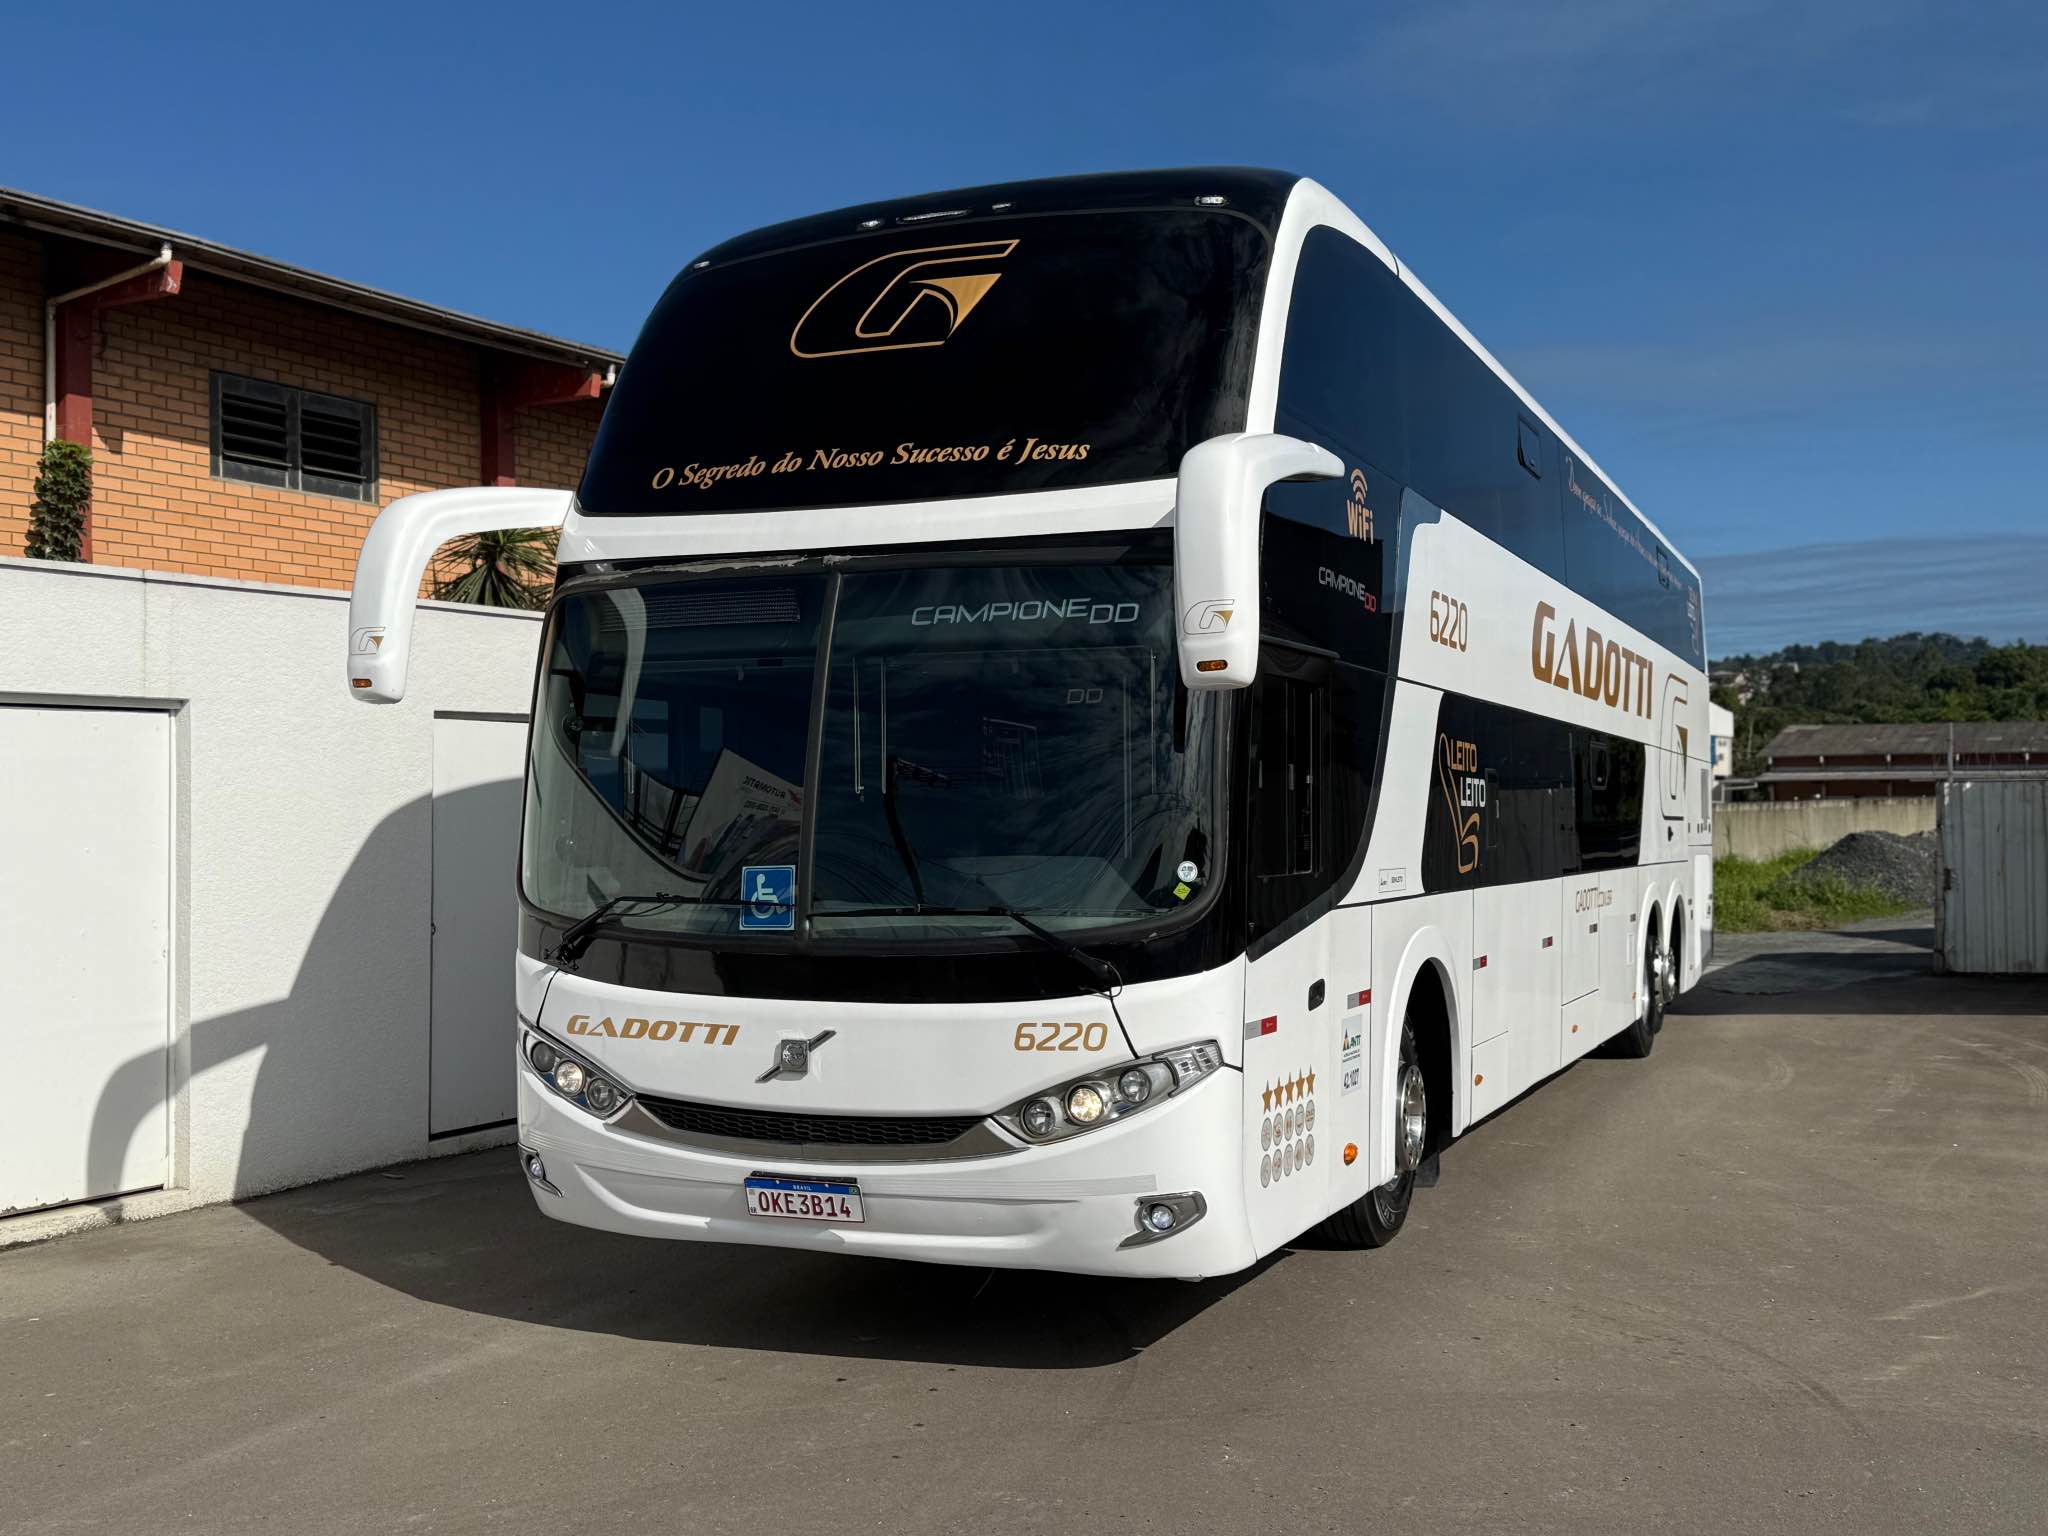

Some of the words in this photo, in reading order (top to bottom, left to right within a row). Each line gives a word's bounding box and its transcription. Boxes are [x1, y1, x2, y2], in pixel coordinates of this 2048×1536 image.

[651, 468, 675, 490] O
[678, 456, 766, 489] Segredo
[771, 452, 802, 474] do
[807, 449, 885, 472] Nosso
[890, 442, 990, 465] Sucesso
[996, 439, 1014, 461] é
[1017, 437, 1091, 464] Jesus
[1429, 589, 1469, 654] 6220
[1531, 600, 1654, 721] GADOTTI
[1450, 738, 1478, 773] LEITO
[1460, 776, 1487, 808] LEITO
[566, 1014, 741, 1047] GADOTTI
[1013, 1022, 1109, 1053] 6220
